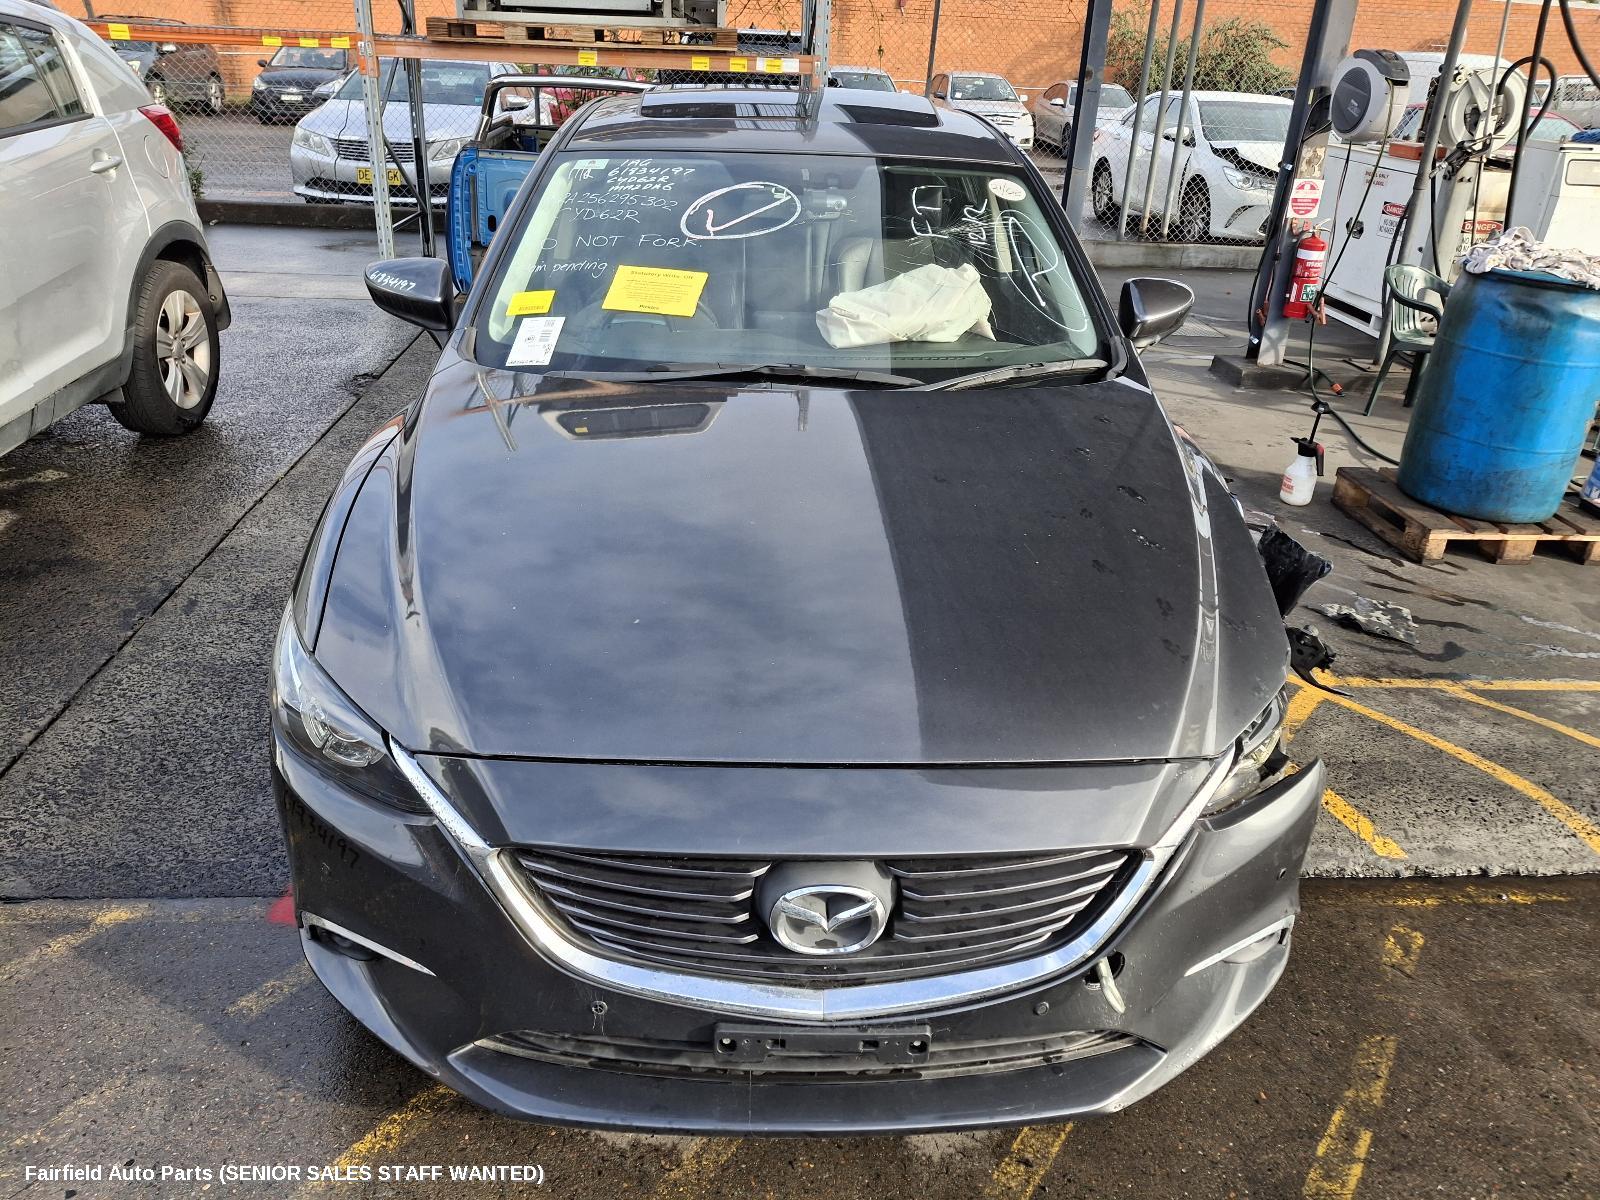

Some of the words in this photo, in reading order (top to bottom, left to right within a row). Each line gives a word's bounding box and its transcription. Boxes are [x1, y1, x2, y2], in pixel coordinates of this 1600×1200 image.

[1386, 205, 1406, 214] DANGE
[575, 234, 624, 248] NOT
[548, 258, 608, 279] pending
